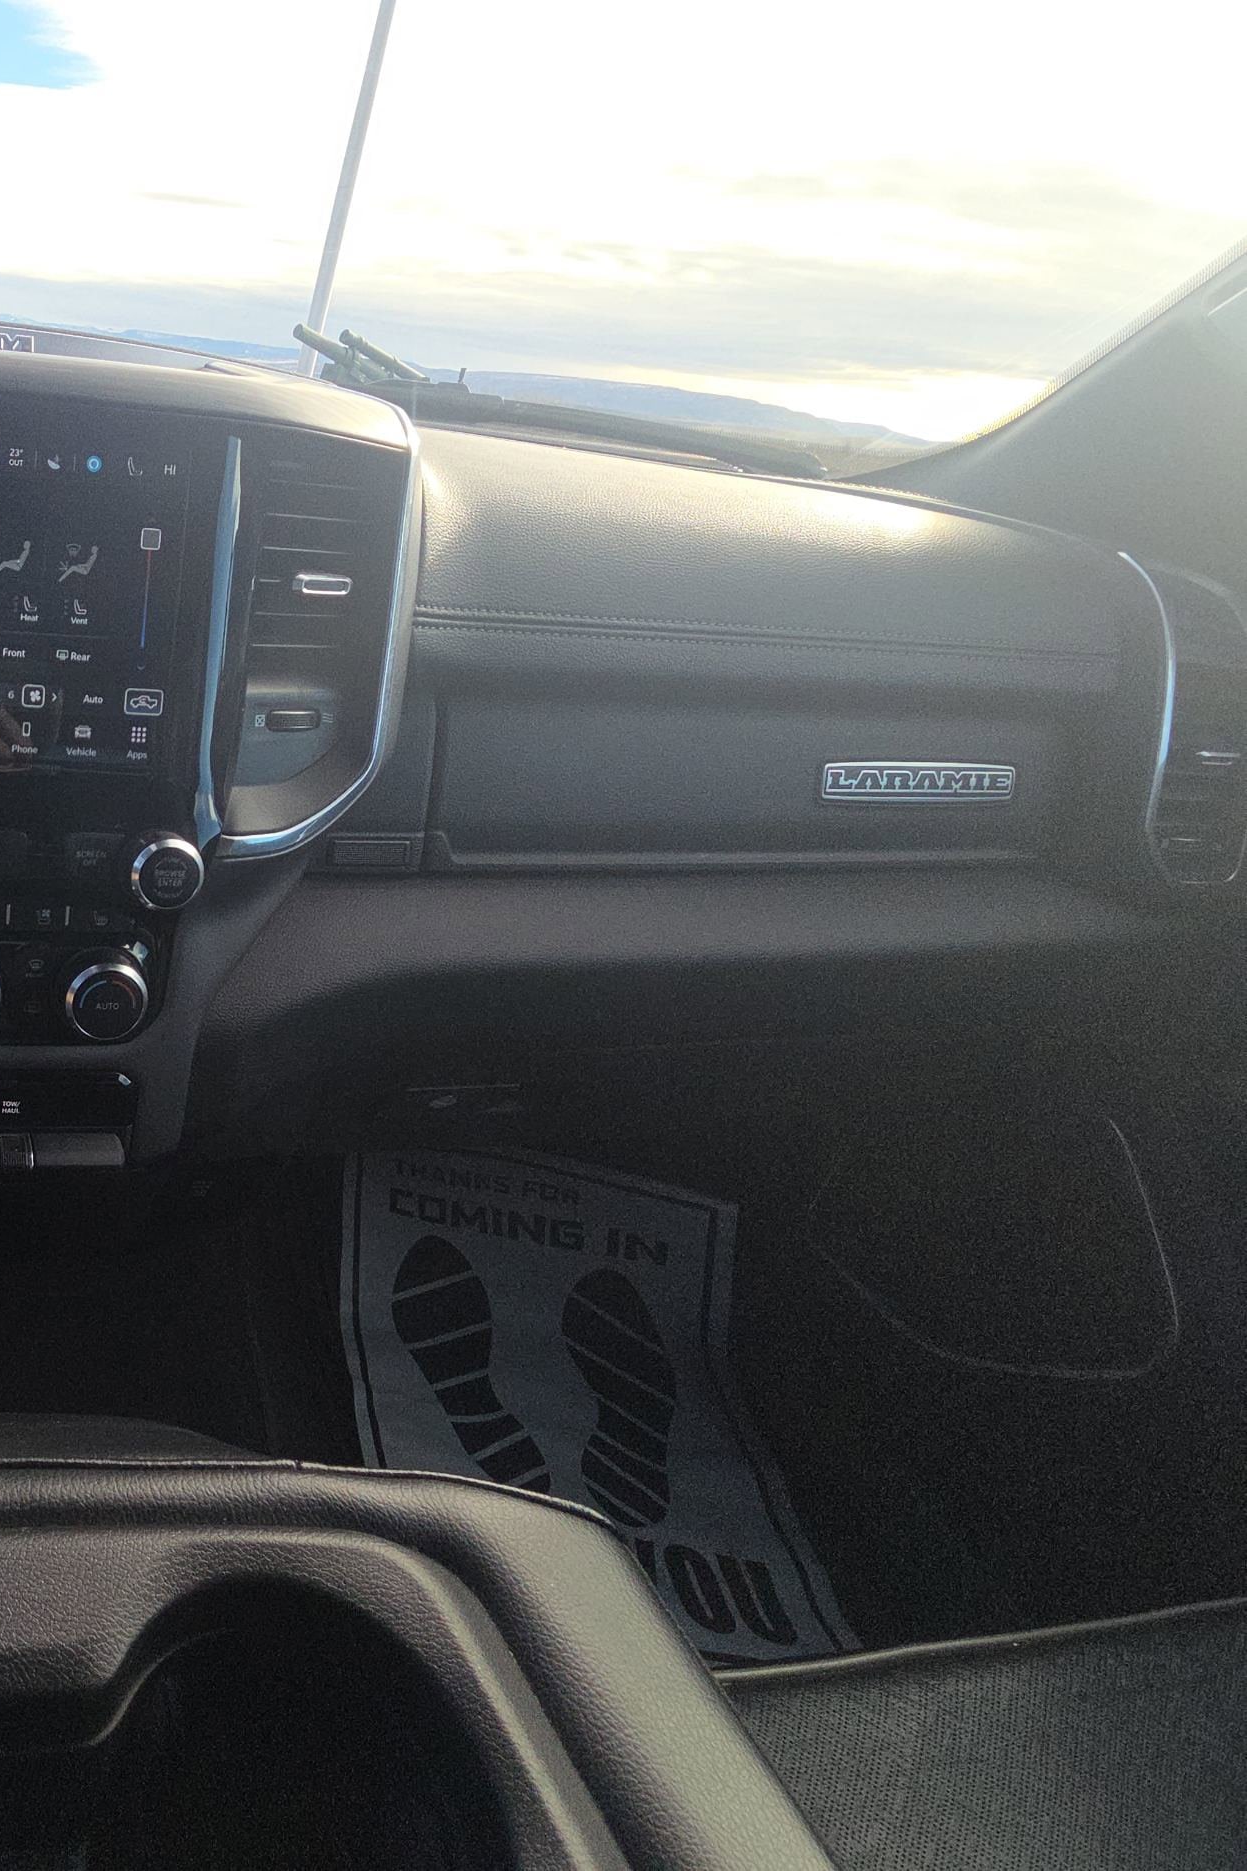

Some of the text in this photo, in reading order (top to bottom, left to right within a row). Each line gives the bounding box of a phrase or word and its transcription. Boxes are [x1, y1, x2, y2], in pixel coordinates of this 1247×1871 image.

[8, 459, 24, 467] OUT
[164, 463, 177, 476] HI
[20, 613, 39, 622] Heat
[70, 616, 88, 625] Vent
[2, 647, 26, 658] Front
[70, 651, 91, 662] Rear
[8, 690, 15, 699] 6
[82, 694, 103, 704] Auto
[11, 744, 38, 755] Phone
[66, 747, 97, 758] Vehicle
[126, 749, 148, 761] Apps
[825, 769, 1013, 793] LARAMIE
[94, 1002, 120, 1011] AUTO
[2, 1100, 21, 1108] TOW/
[1, 1107, 21, 1115] HAUL
[391, 1157, 581, 1206] THANKS FOR
[388, 1187, 669, 1266] COMING IN
[634, 1537, 799, 1647] OU
